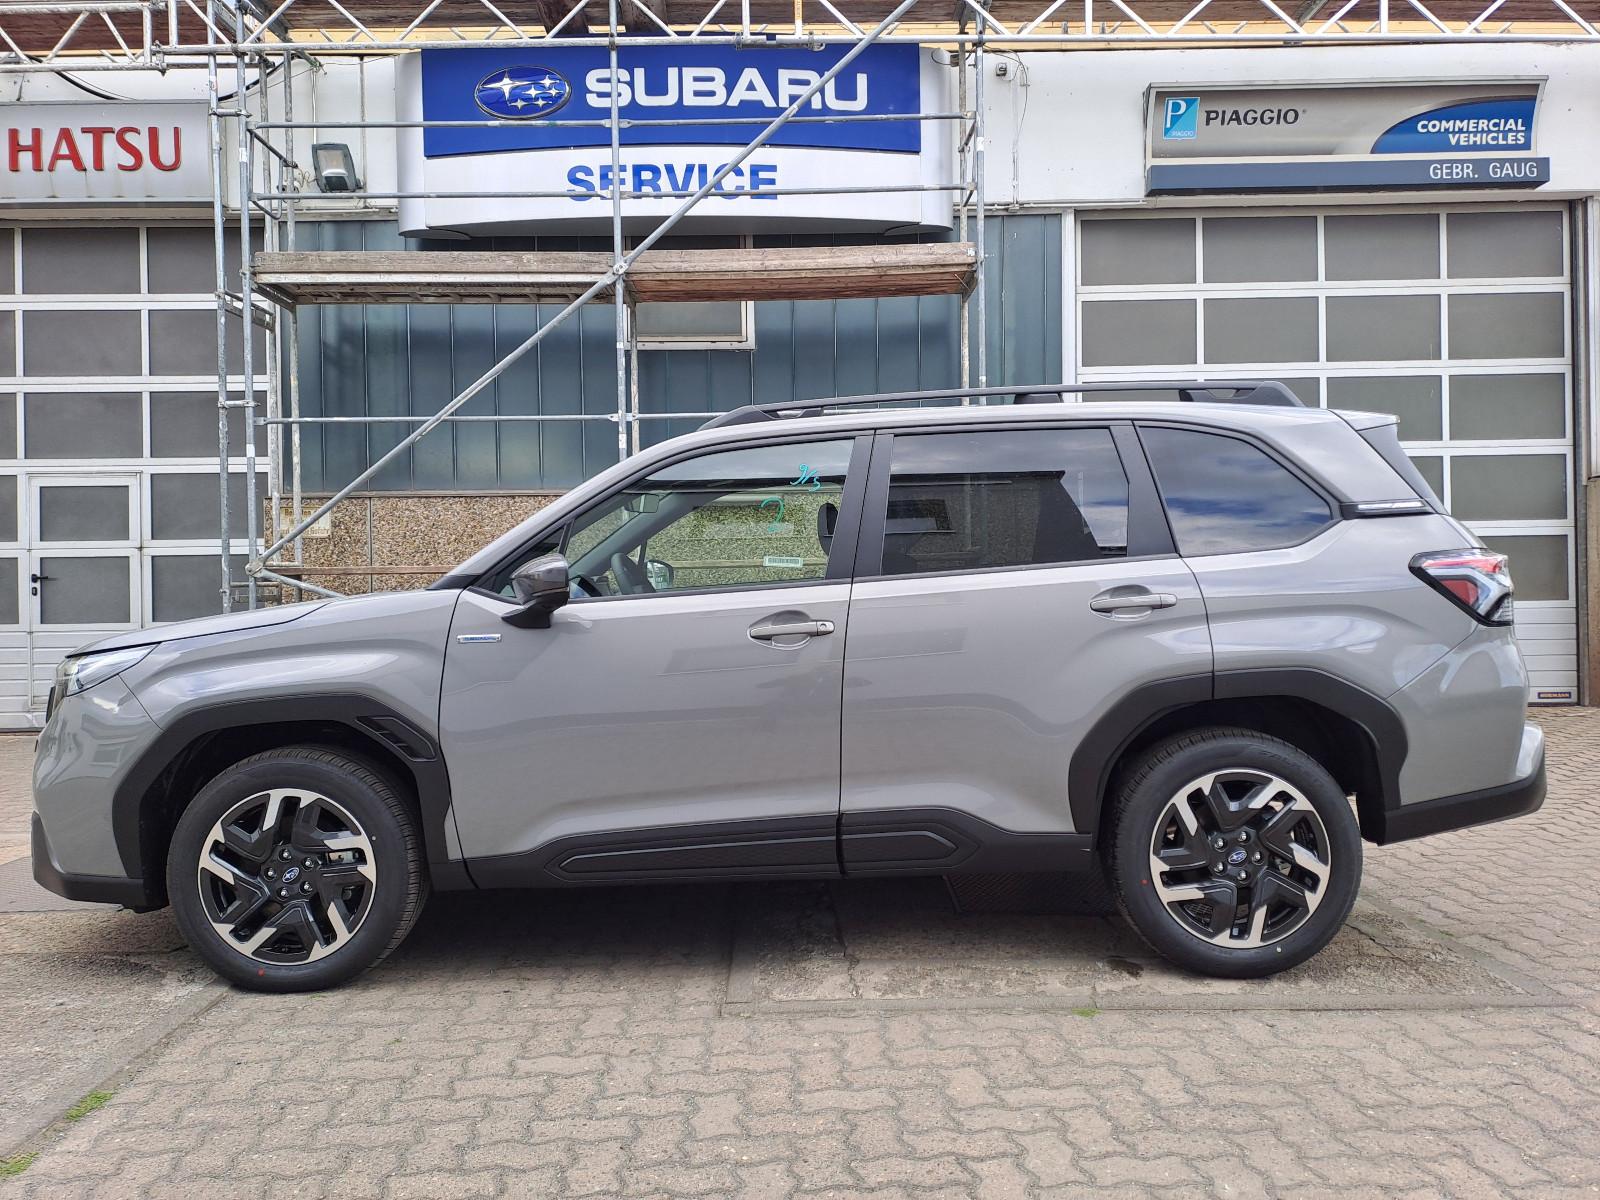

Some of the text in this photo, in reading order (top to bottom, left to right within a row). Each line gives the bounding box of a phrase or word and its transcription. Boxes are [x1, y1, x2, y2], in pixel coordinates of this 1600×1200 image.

[585, 66, 868, 112] SUBARU
[1204, 108, 1299, 126] PIAGGIO
[1416, 118, 1526, 133] COMMERCIAL
[1448, 132, 1525, 146] VEHICLES
[8, 126, 182, 172] HATSU
[1429, 161, 1538, 179] GEBR. GAUG
[566, 162, 778, 202] SERVICE
